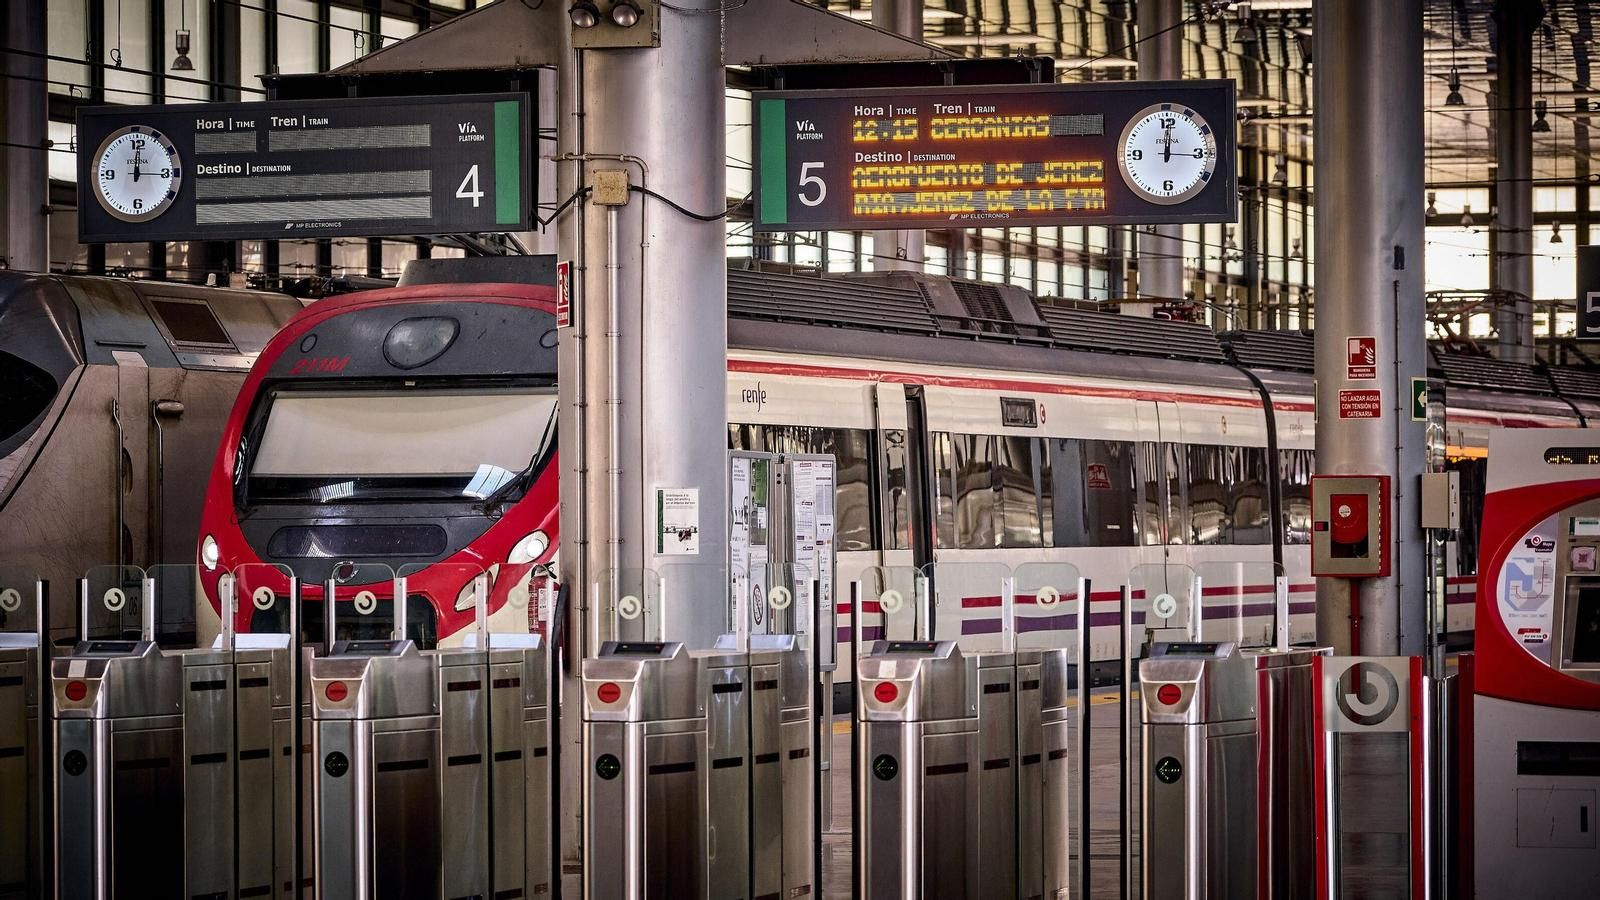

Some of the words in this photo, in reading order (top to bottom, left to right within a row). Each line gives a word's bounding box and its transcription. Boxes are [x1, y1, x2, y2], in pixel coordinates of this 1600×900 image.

[854, 105, 884, 116] Hora
[896, 107, 917, 115] TIME
[933, 103, 962, 114] Tren
[196, 119, 224, 130] Hora
[235, 120, 255, 128] TIME
[270, 116, 298, 127] Tren
[931, 115, 1050, 139] CERCANIAS
[1159, 118, 1176, 129] 12
[458, 134, 485, 142] PLATFORM
[796, 132, 824, 140] PLATFORM
[130, 139, 146, 150] 12
[855, 151, 903, 163] Destino
[913, 153, 956, 161] DESTINATION
[1132, 149, 1143, 161] 9
[1193, 147, 1204, 159] 3
[105, 169, 115, 181] 9
[160, 167, 170, 179] 3
[196, 163, 242, 175] Destino
[252, 164, 292, 172] DESTINATION
[853, 163, 984, 188] AEROPUERTO
[996, 163, 1023, 184] DE
[1036, 161, 1103, 183] JEREZ
[455, 164, 485, 208] 4
[798, 161, 827, 207] 5
[1163, 180, 1174, 191] 6
[133, 198, 143, 210] 6
[986, 190, 1014, 211] DE
[741, 381, 767, 413] renfe
